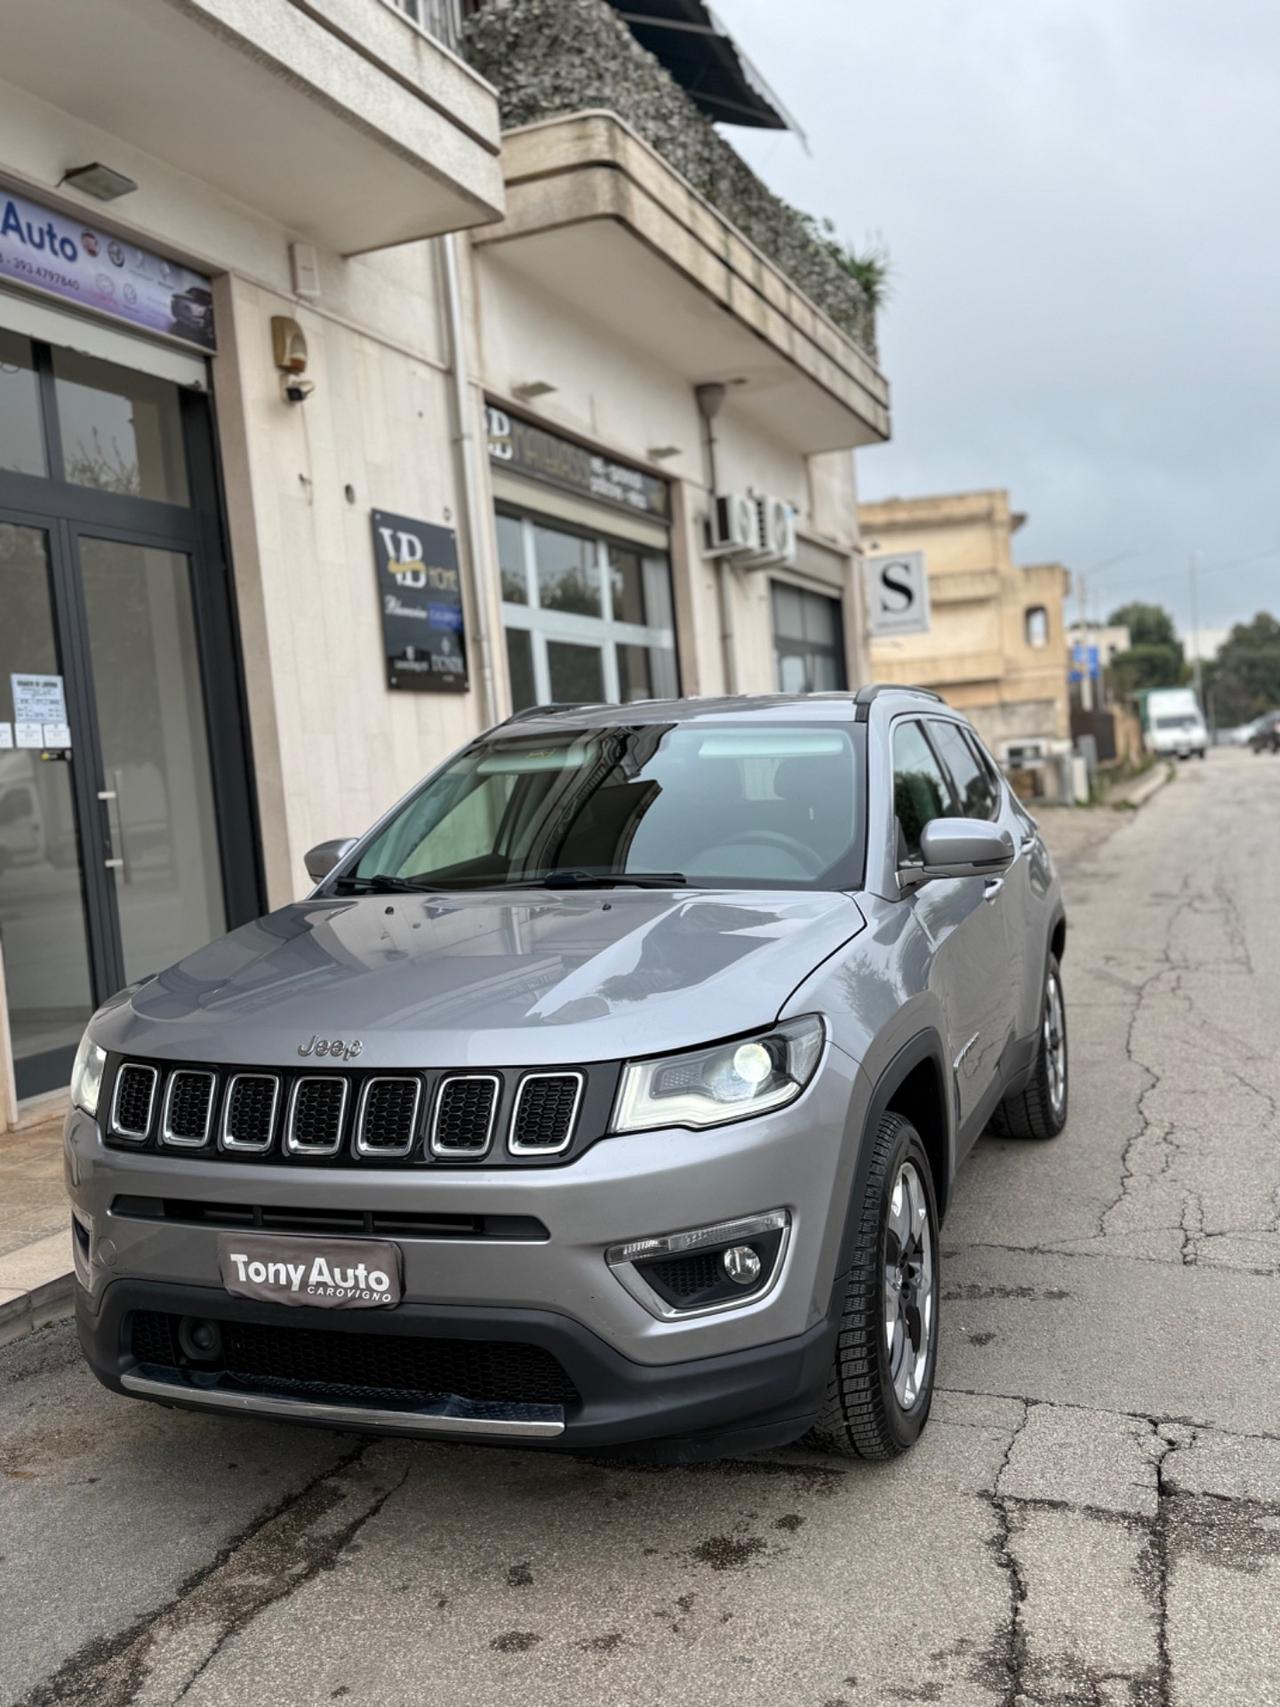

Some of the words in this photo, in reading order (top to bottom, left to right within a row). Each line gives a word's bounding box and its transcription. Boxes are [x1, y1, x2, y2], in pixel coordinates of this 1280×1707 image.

[1, 201, 78, 262] Auto
[881, 561, 915, 615] S
[298, 1034, 362, 1062] Jeep
[230, 1253, 306, 1292] Tony
[308, 1257, 390, 1292] Auto
[307, 1286, 392, 1302] CAROVIGNO
